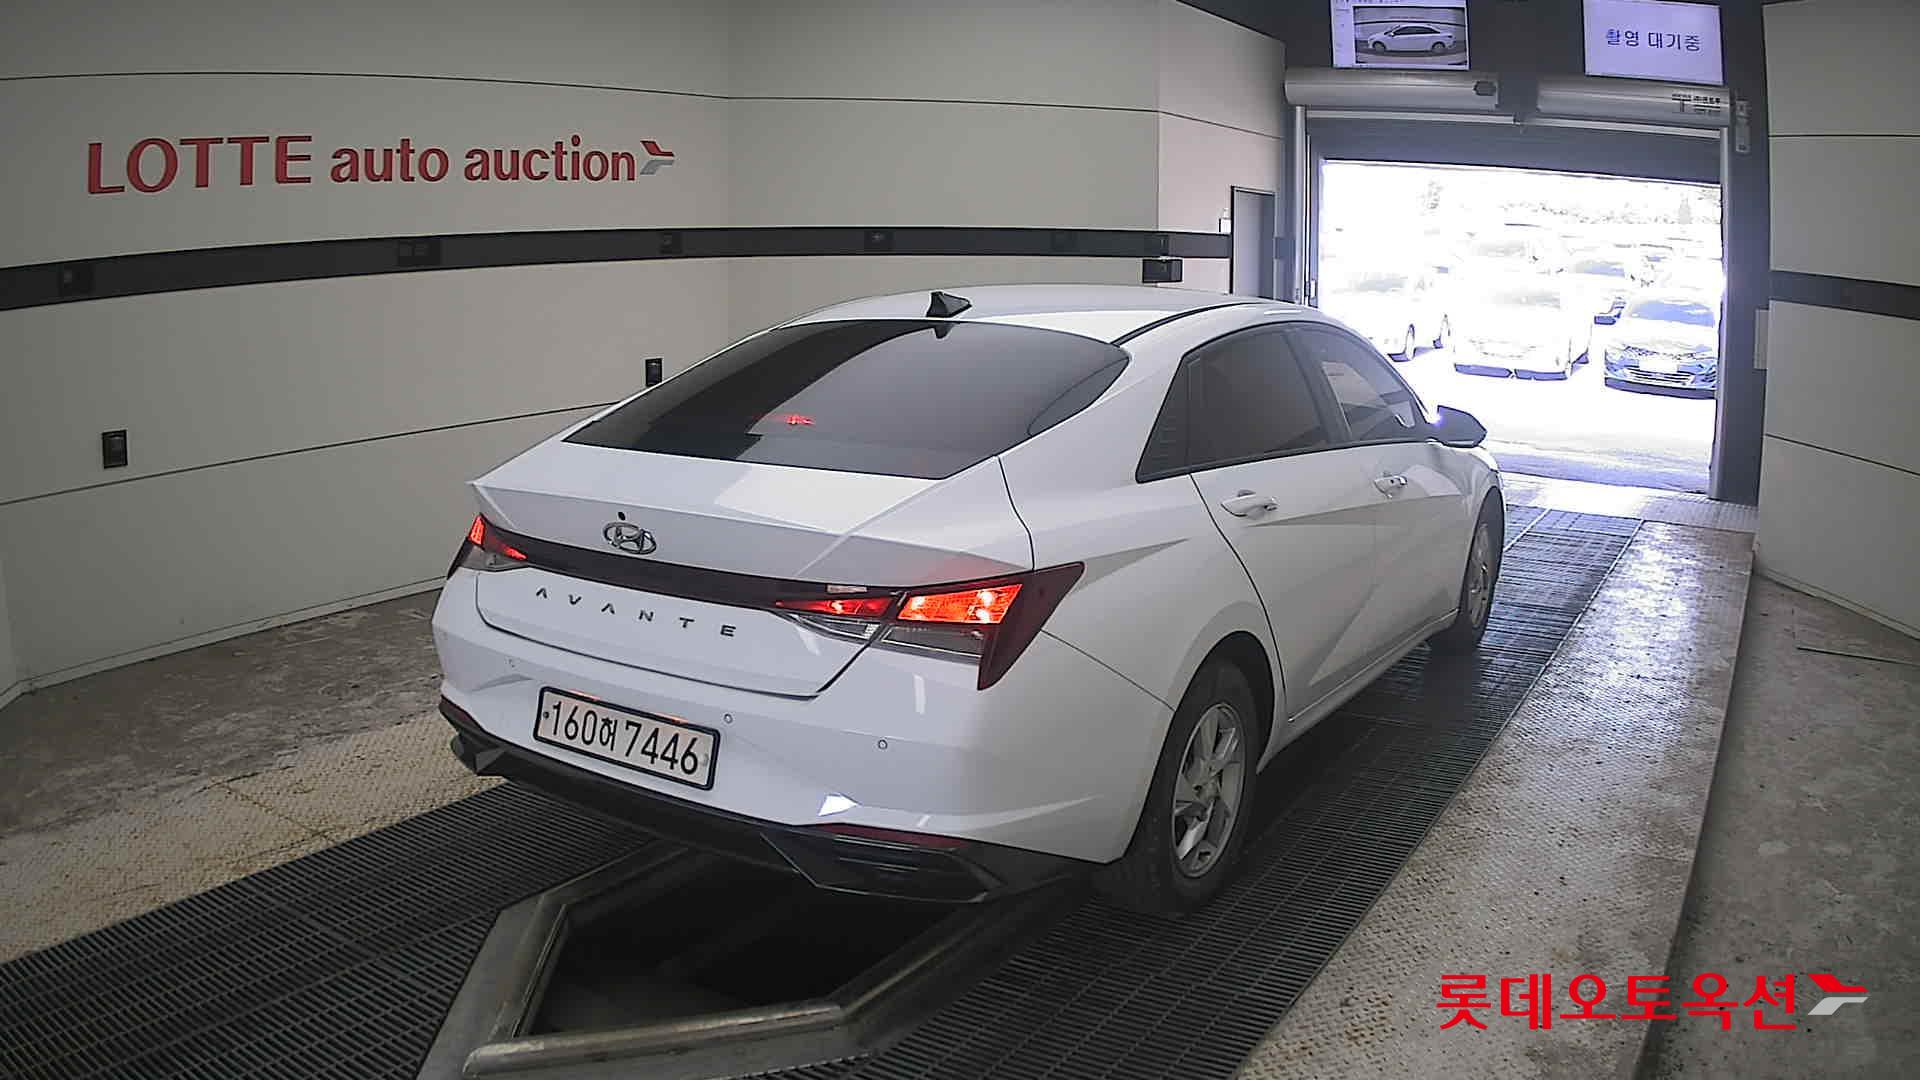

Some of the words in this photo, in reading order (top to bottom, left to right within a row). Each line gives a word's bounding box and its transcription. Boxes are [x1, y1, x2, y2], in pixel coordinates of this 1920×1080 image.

[1648, 32, 1701, 52] 대기중
[87, 135, 312, 195] LOTTE
[330, 138, 449, 183] auto
[464, 135, 635, 182] auction
[535, 586, 737, 638] AVANTE
